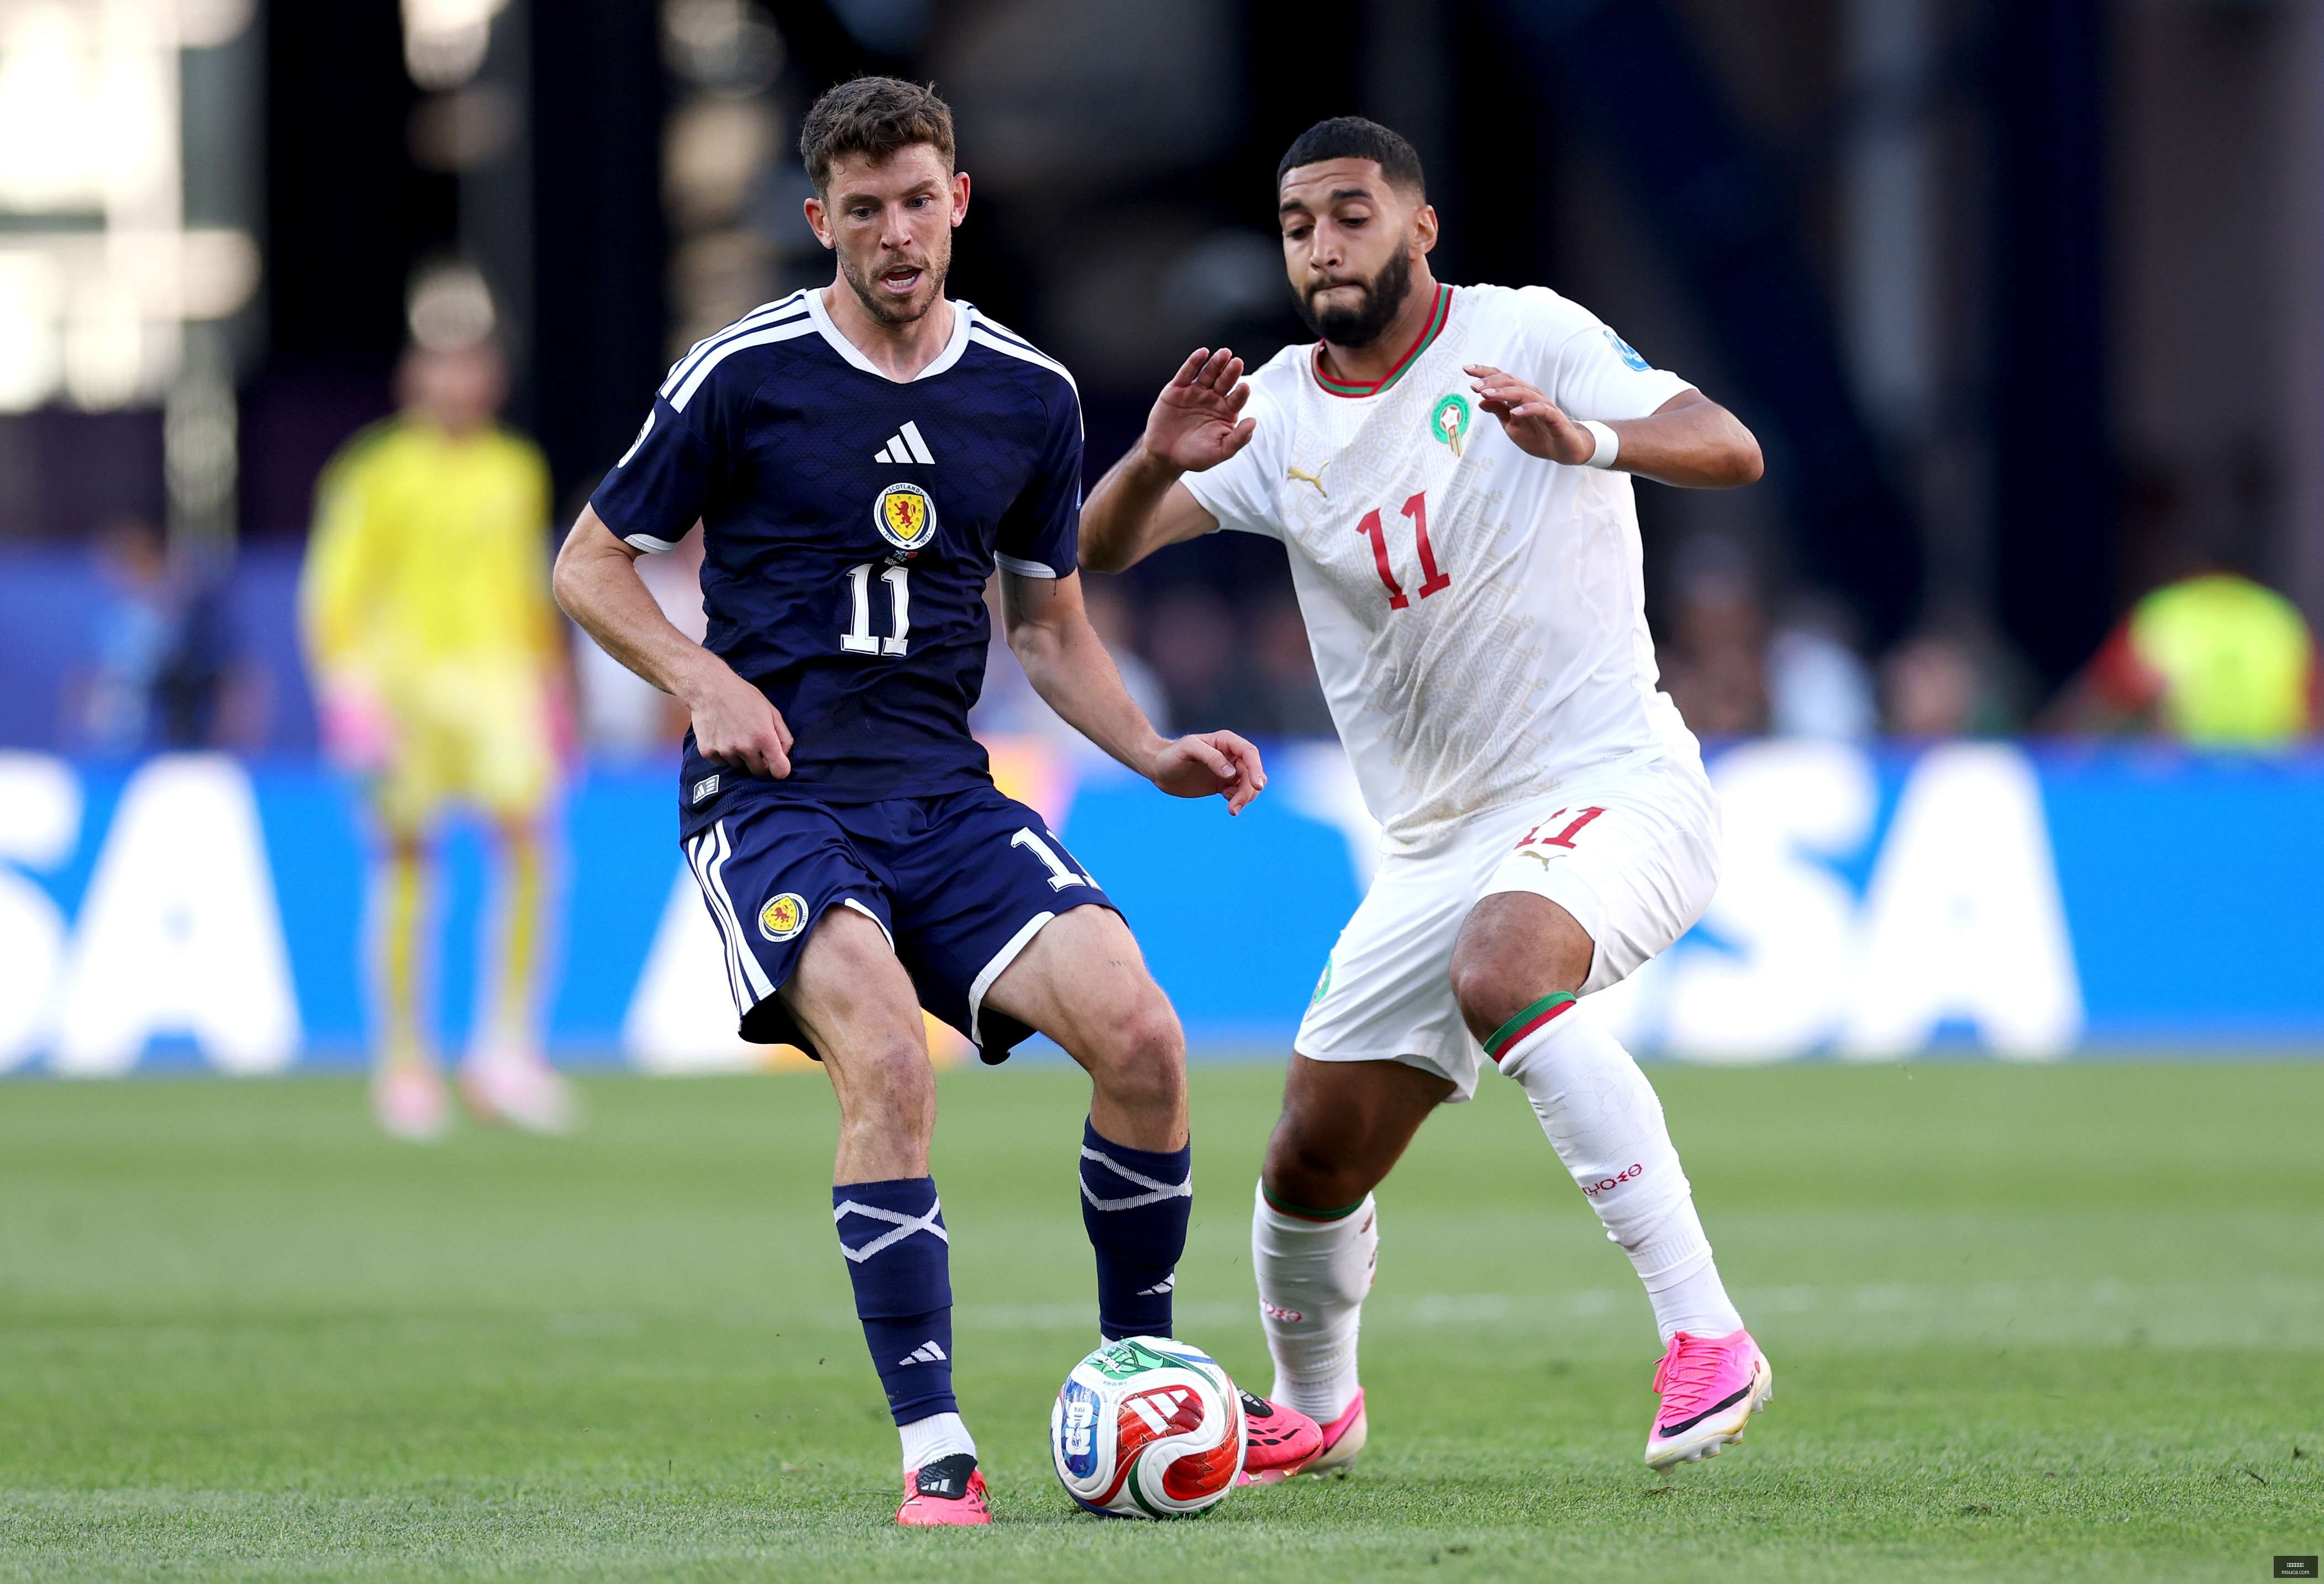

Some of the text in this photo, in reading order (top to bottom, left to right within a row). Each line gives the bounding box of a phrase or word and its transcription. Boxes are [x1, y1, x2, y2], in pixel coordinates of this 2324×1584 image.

[888, 484, 920, 493] SCOTLAND
[884, 556, 900, 566] BOS
[920, 535, 929, 544] 1873
[1356, 491, 1450, 610] 11
[841, 564, 909, 656] 11
[1514, 806, 1607, 849] 11
[1011, 827, 1103, 892] 1
